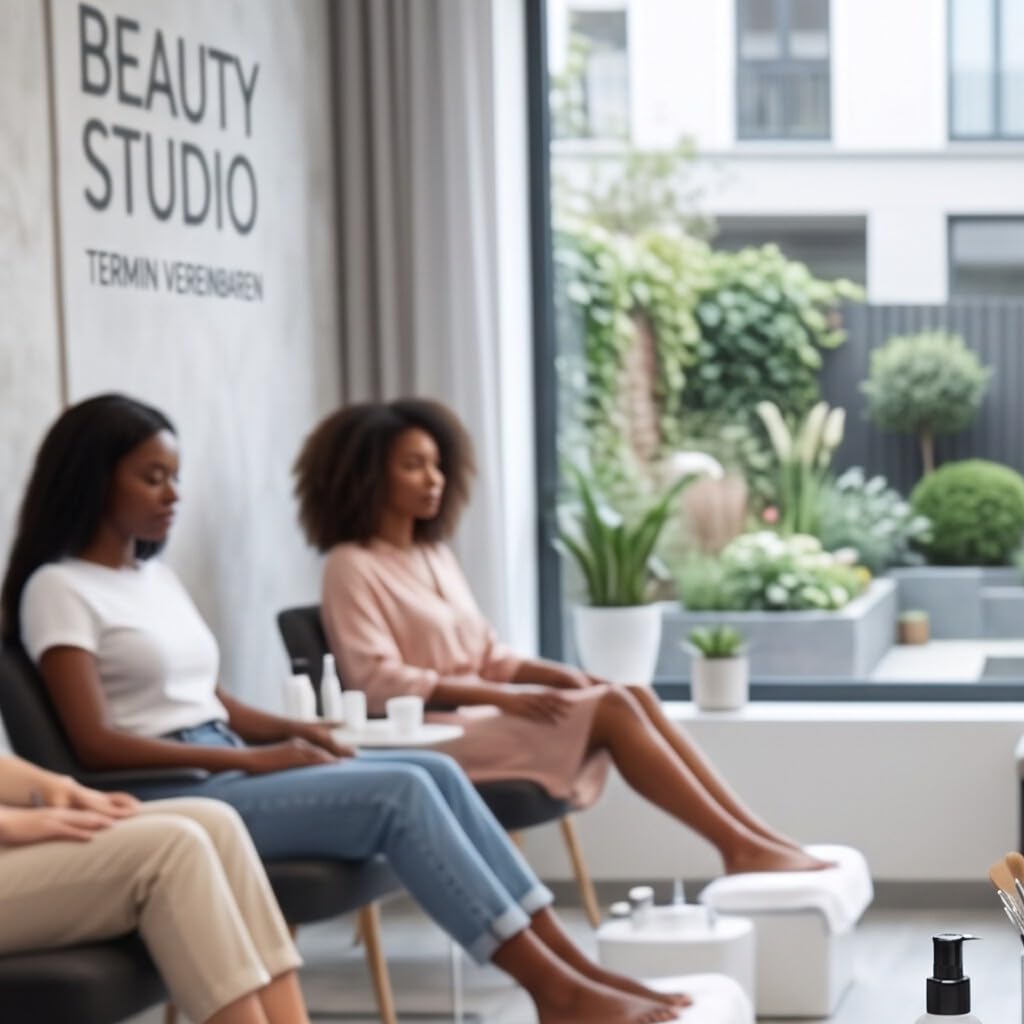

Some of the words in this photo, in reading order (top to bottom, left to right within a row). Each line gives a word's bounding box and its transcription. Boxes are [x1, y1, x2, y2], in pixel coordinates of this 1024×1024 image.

[79, 2, 260, 138] BEAUTY
[82, 117, 259, 236] STUDIO
[85, 249, 159, 292] TERMIN
